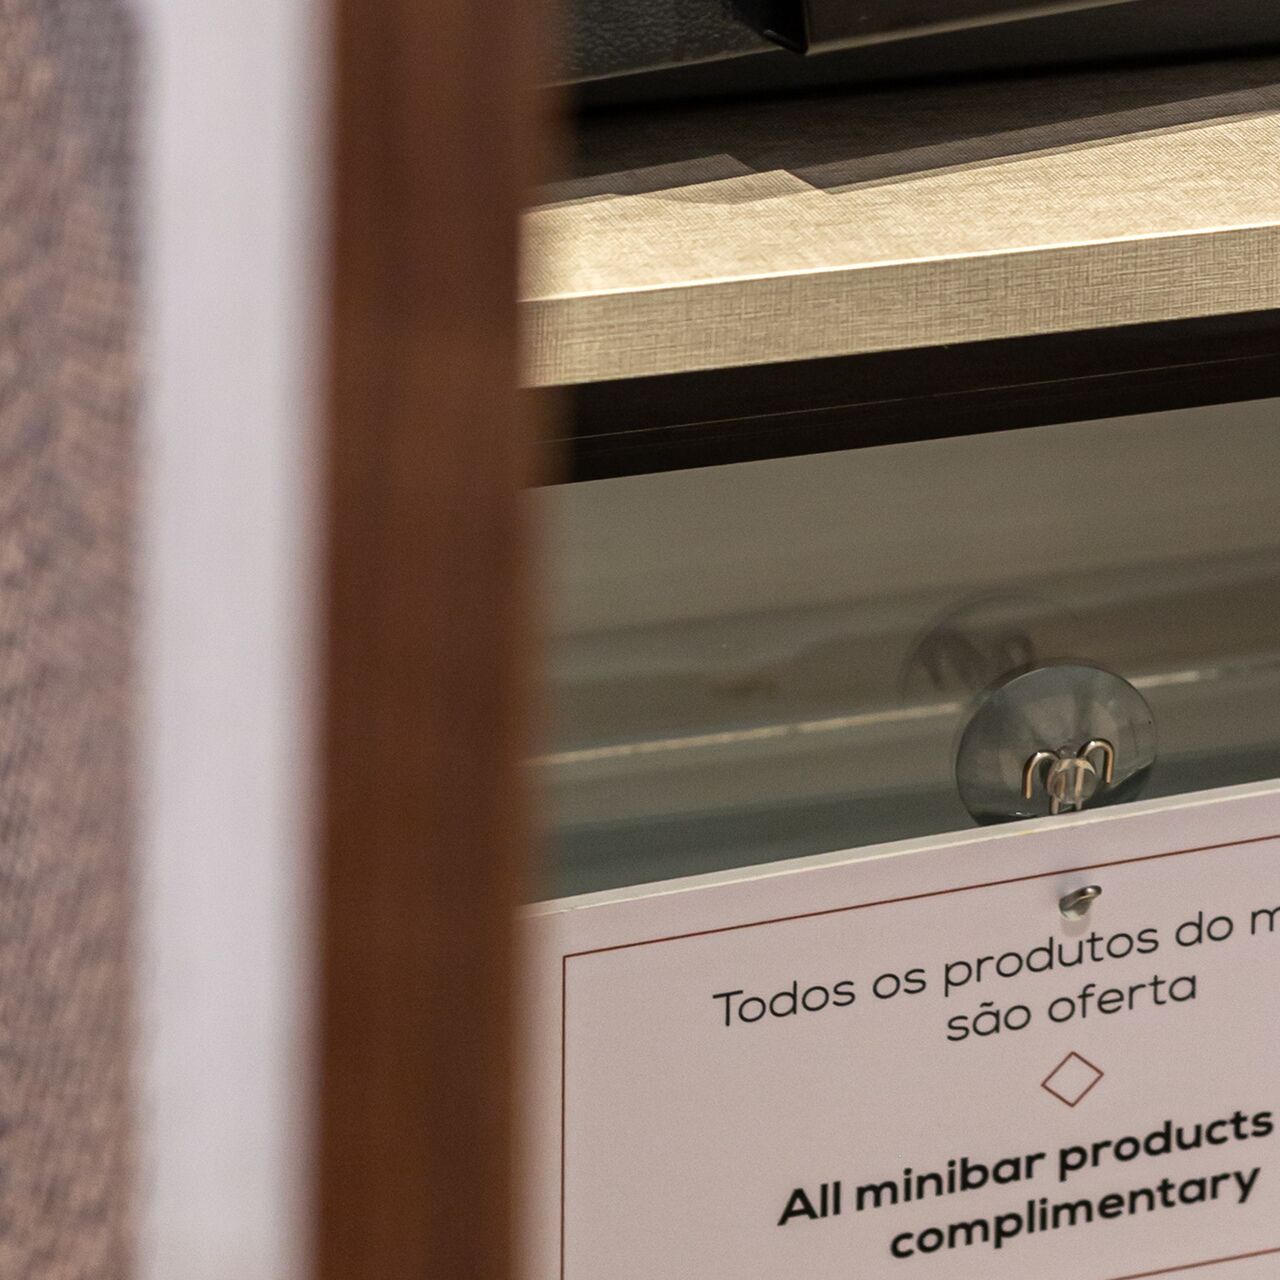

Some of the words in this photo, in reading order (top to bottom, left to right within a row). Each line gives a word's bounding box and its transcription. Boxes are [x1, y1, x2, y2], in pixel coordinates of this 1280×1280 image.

[712, 980, 856, 1027] Todos
[872, 968, 927, 1000] os
[944, 928, 1159, 998] produtos
[1175, 910, 1234, 948] do
[946, 1001, 1032, 1042] são
[1047, 974, 1197, 1023] oferta
[777, 1180, 841, 1226] All
[856, 1149, 1046, 1213] minibar
[1058, 1109, 1274, 1183] products
[889, 1166, 1261, 1259] complimentary
